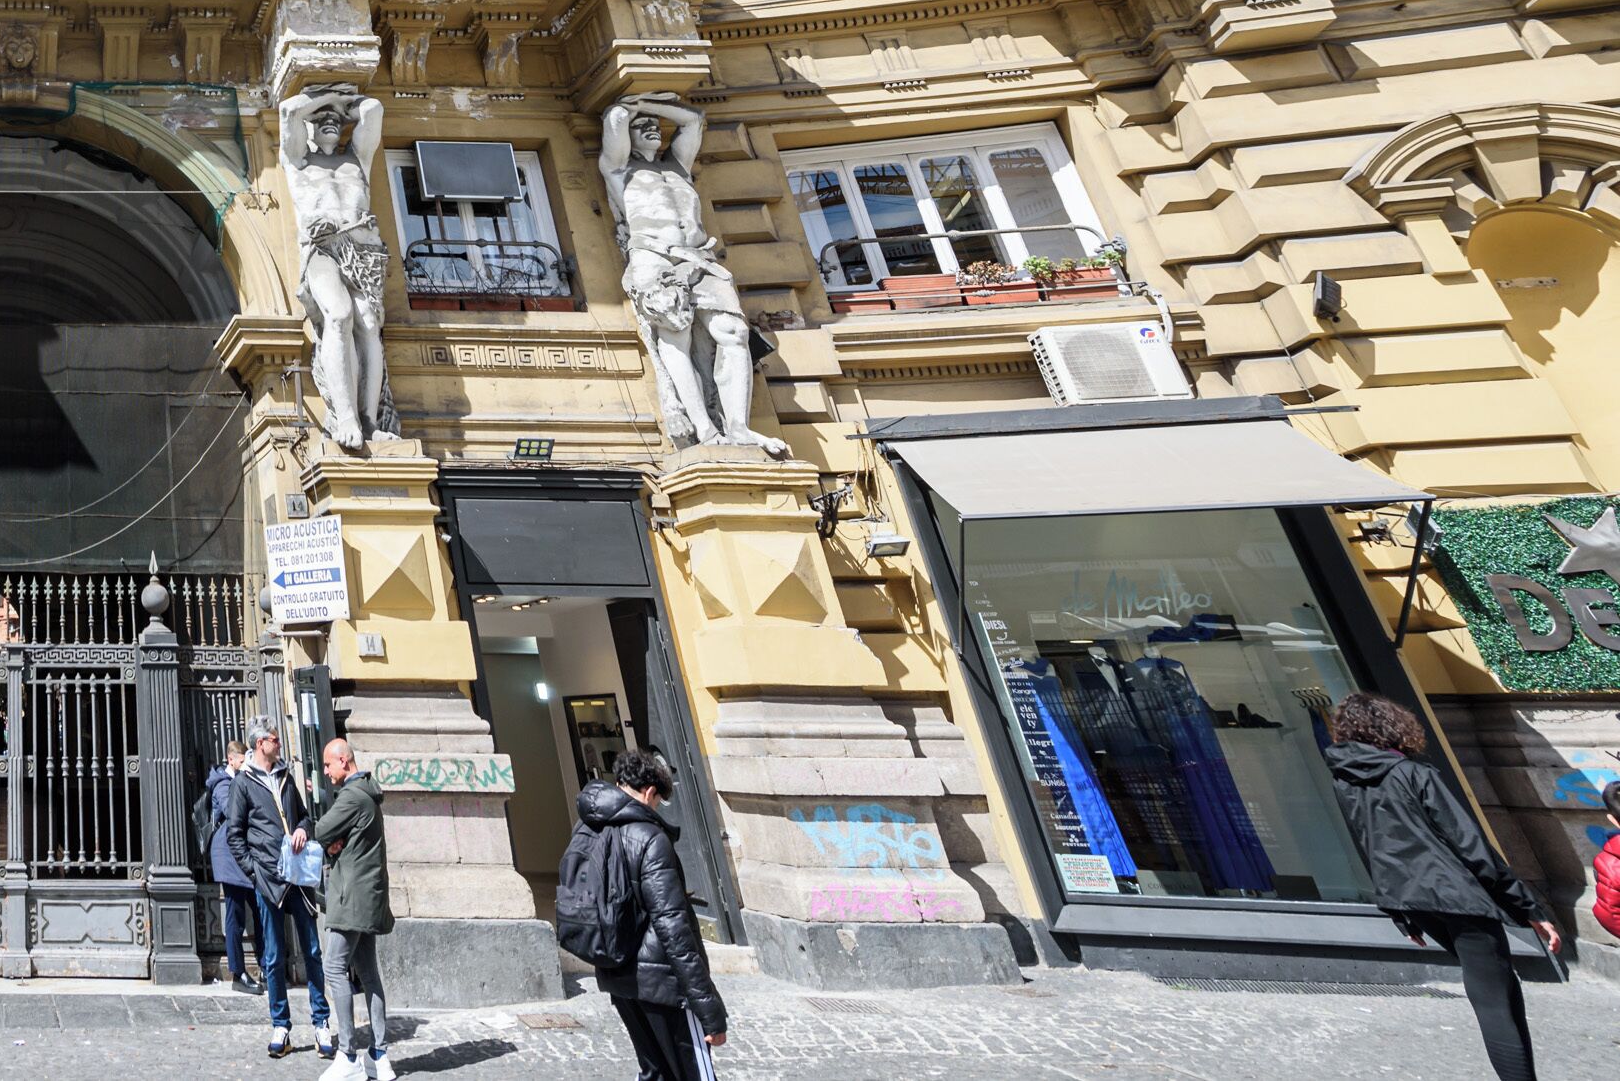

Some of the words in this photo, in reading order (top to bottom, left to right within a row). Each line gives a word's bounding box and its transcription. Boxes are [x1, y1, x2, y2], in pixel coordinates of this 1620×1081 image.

[266, 526, 291, 541] MICRO
[293, 519, 339, 537] ACUSTICA
[268, 540, 305, 553] APPARECCHI
[307, 535, 340, 548] ACUSTICI
[275, 557, 289, 567] TEL.
[284, 572, 293, 585] IN
[293, 569, 333, 584] GALLERIA
[273, 592, 308, 605] CONTROLLO
[310, 590, 345, 602] GRATUITO
[1104, 568, 1213, 629] Matteo
[286, 607, 328, 619] DELL'UDITO
